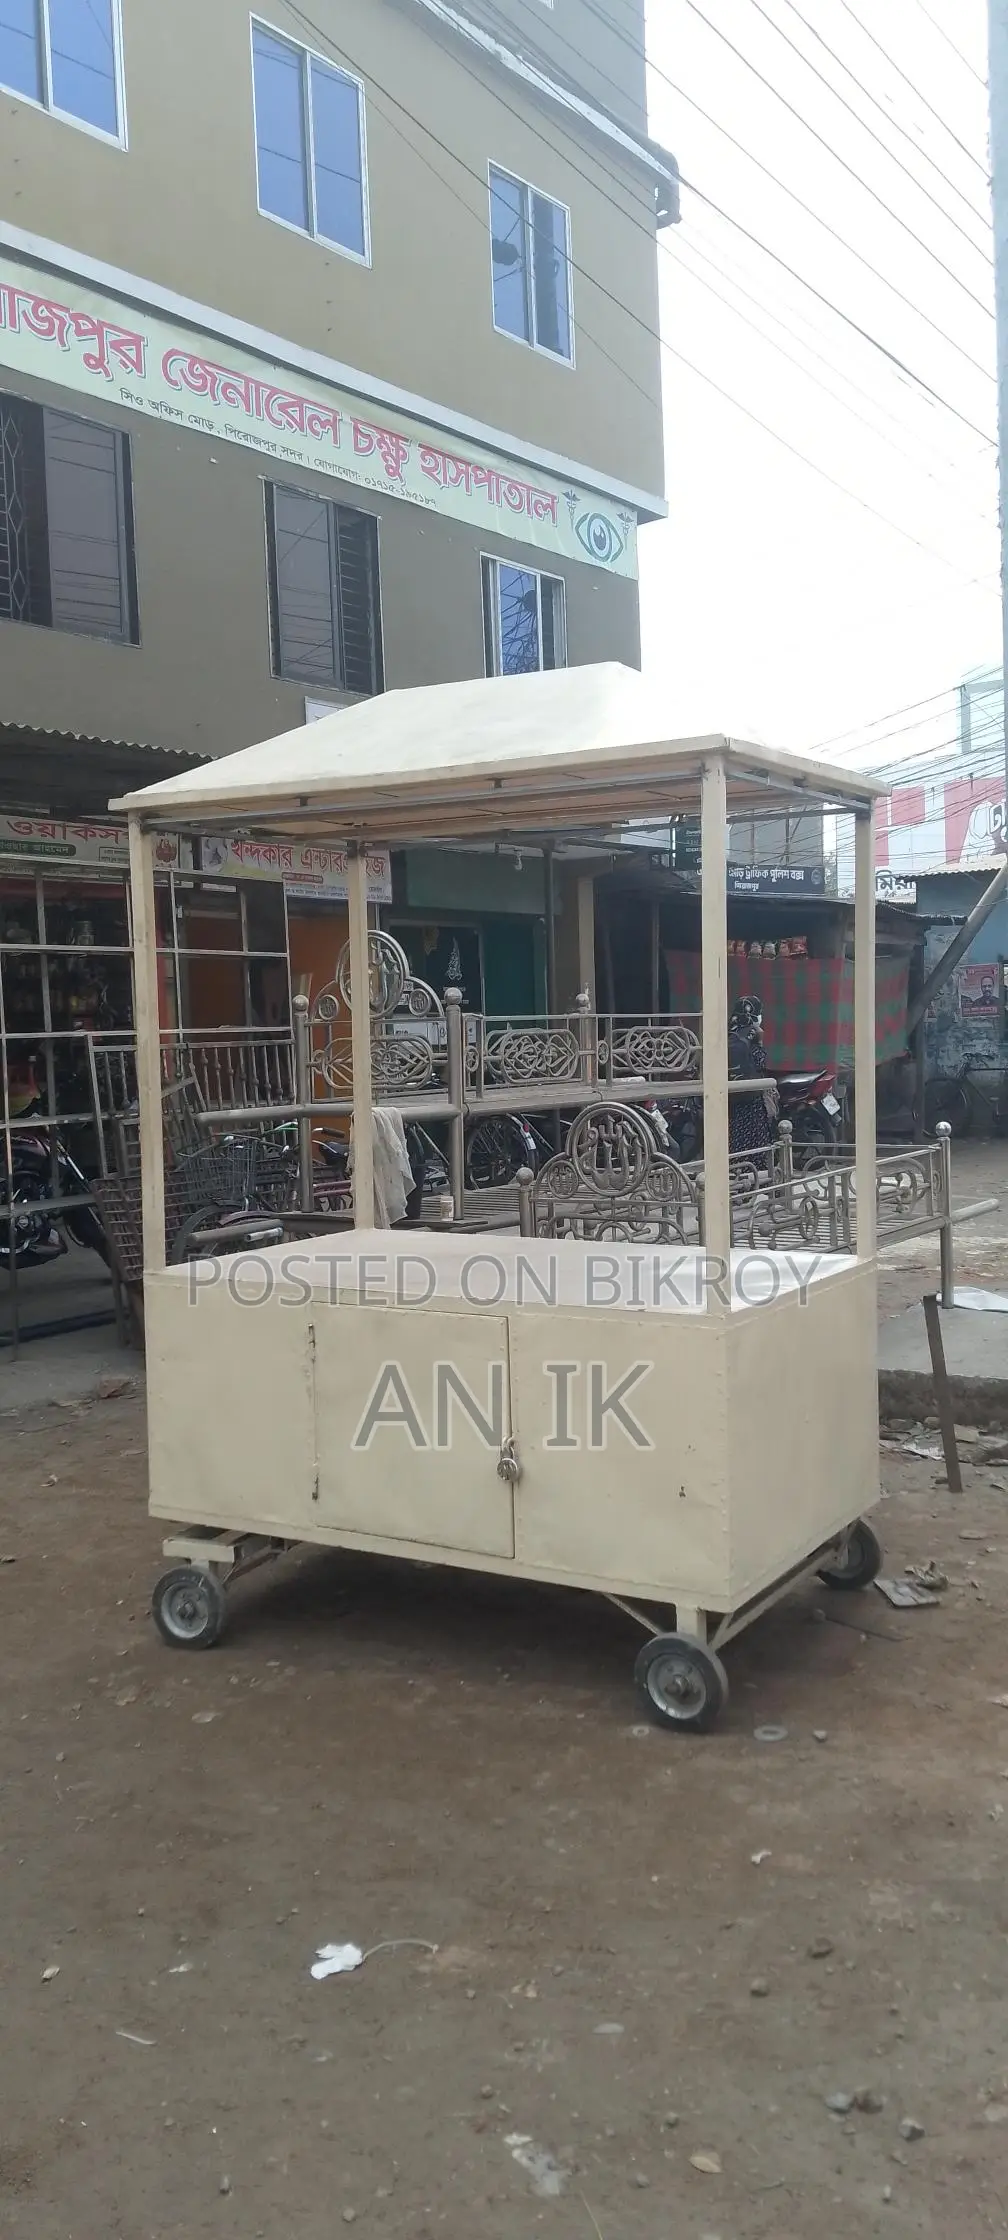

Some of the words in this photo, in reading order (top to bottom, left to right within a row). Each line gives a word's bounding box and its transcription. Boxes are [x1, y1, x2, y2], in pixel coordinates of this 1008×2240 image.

[120, 387, 144, 406] সিও
[148, 399, 184, 420] অফিস
[224, 423, 277, 453] পিরোজপুর
[162, 348, 342, 449] জেনারেল
[350, 416, 411, 488] চক্ষু
[418, 443, 558, 527] হাসপাতাল
[745, 864, 769, 880] ট্রাফিক
[770, 866, 789, 883] পুলিশ
